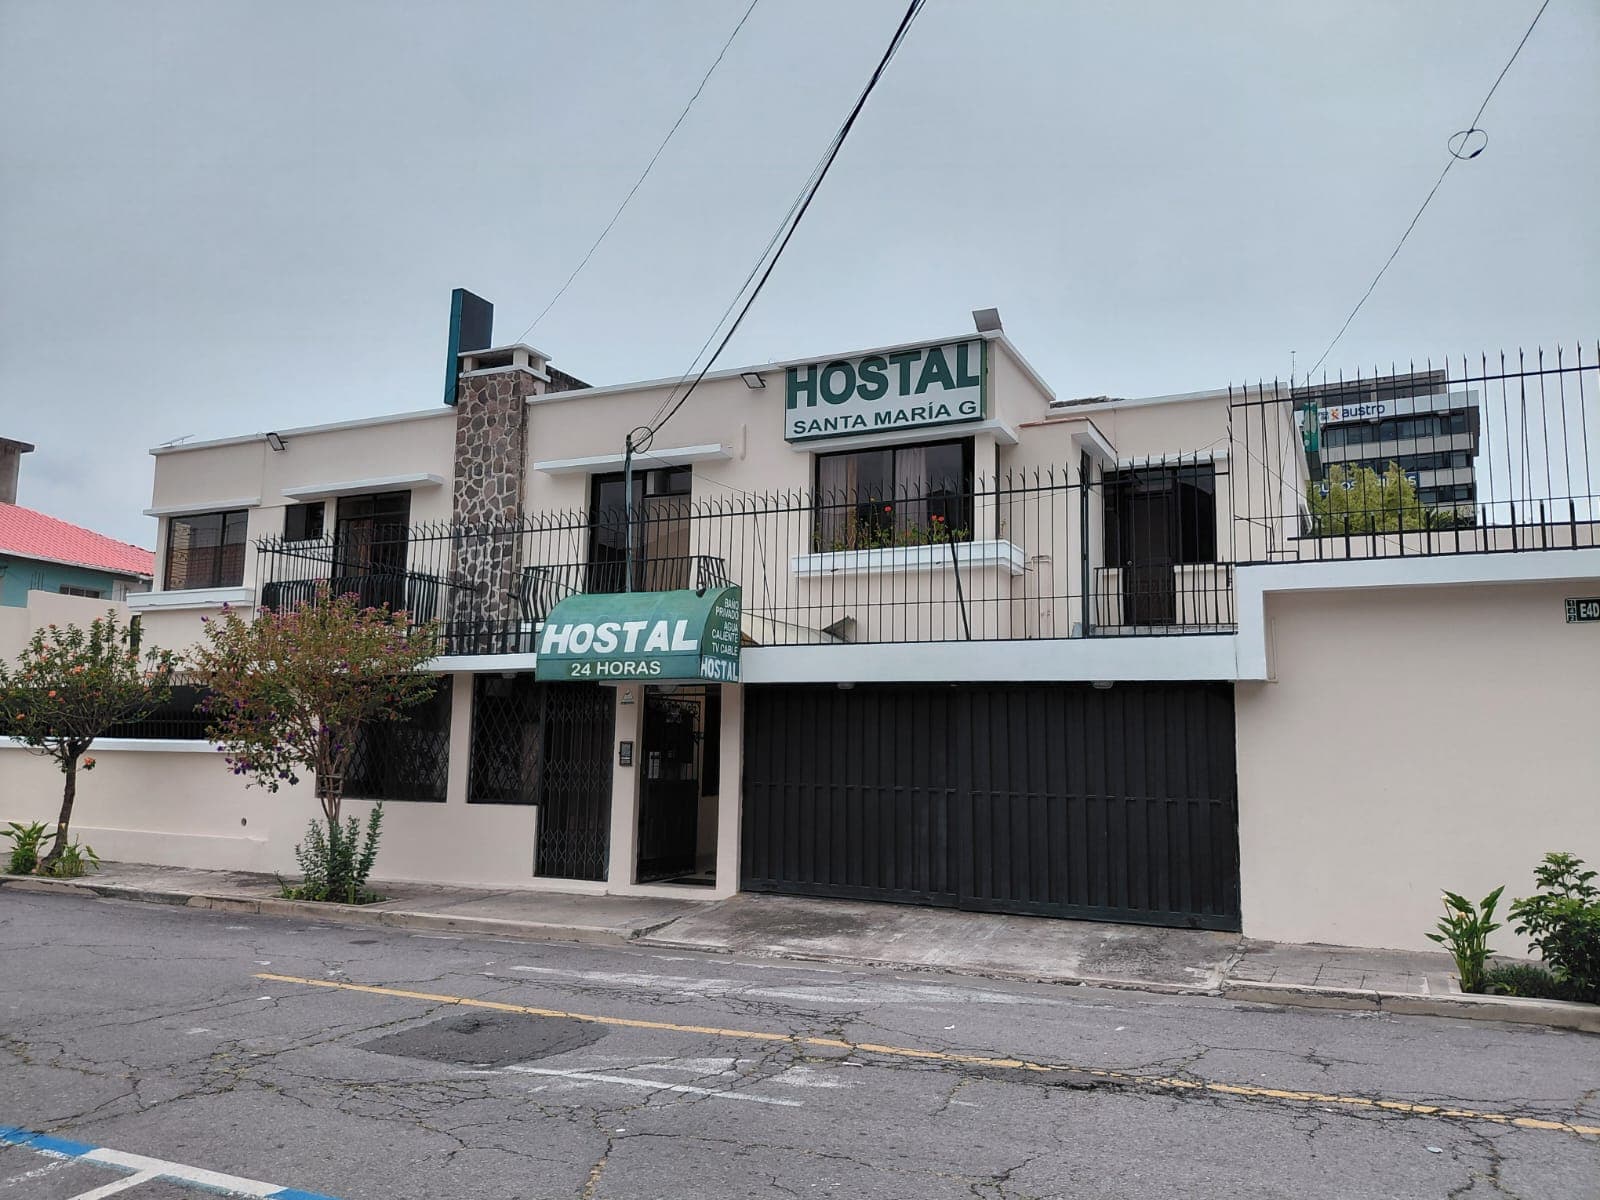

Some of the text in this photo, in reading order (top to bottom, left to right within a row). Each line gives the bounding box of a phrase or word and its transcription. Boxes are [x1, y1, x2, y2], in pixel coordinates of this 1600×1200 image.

[787, 344, 979, 409] HOSTAL
[793, 400, 976, 434] SANTA MARÍA G
[1342, 404, 1385, 418] austro
[716, 606, 739, 620] PRIVADO
[724, 621, 738, 632] AGUA
[541, 620, 697, 654] HOSTAL
[712, 629, 738, 643] CALIENTE
[712, 643, 738, 656] TV CABLE
[571, 661, 660, 676] 24 HORAS
[701, 657, 738, 681] HOSTAL
